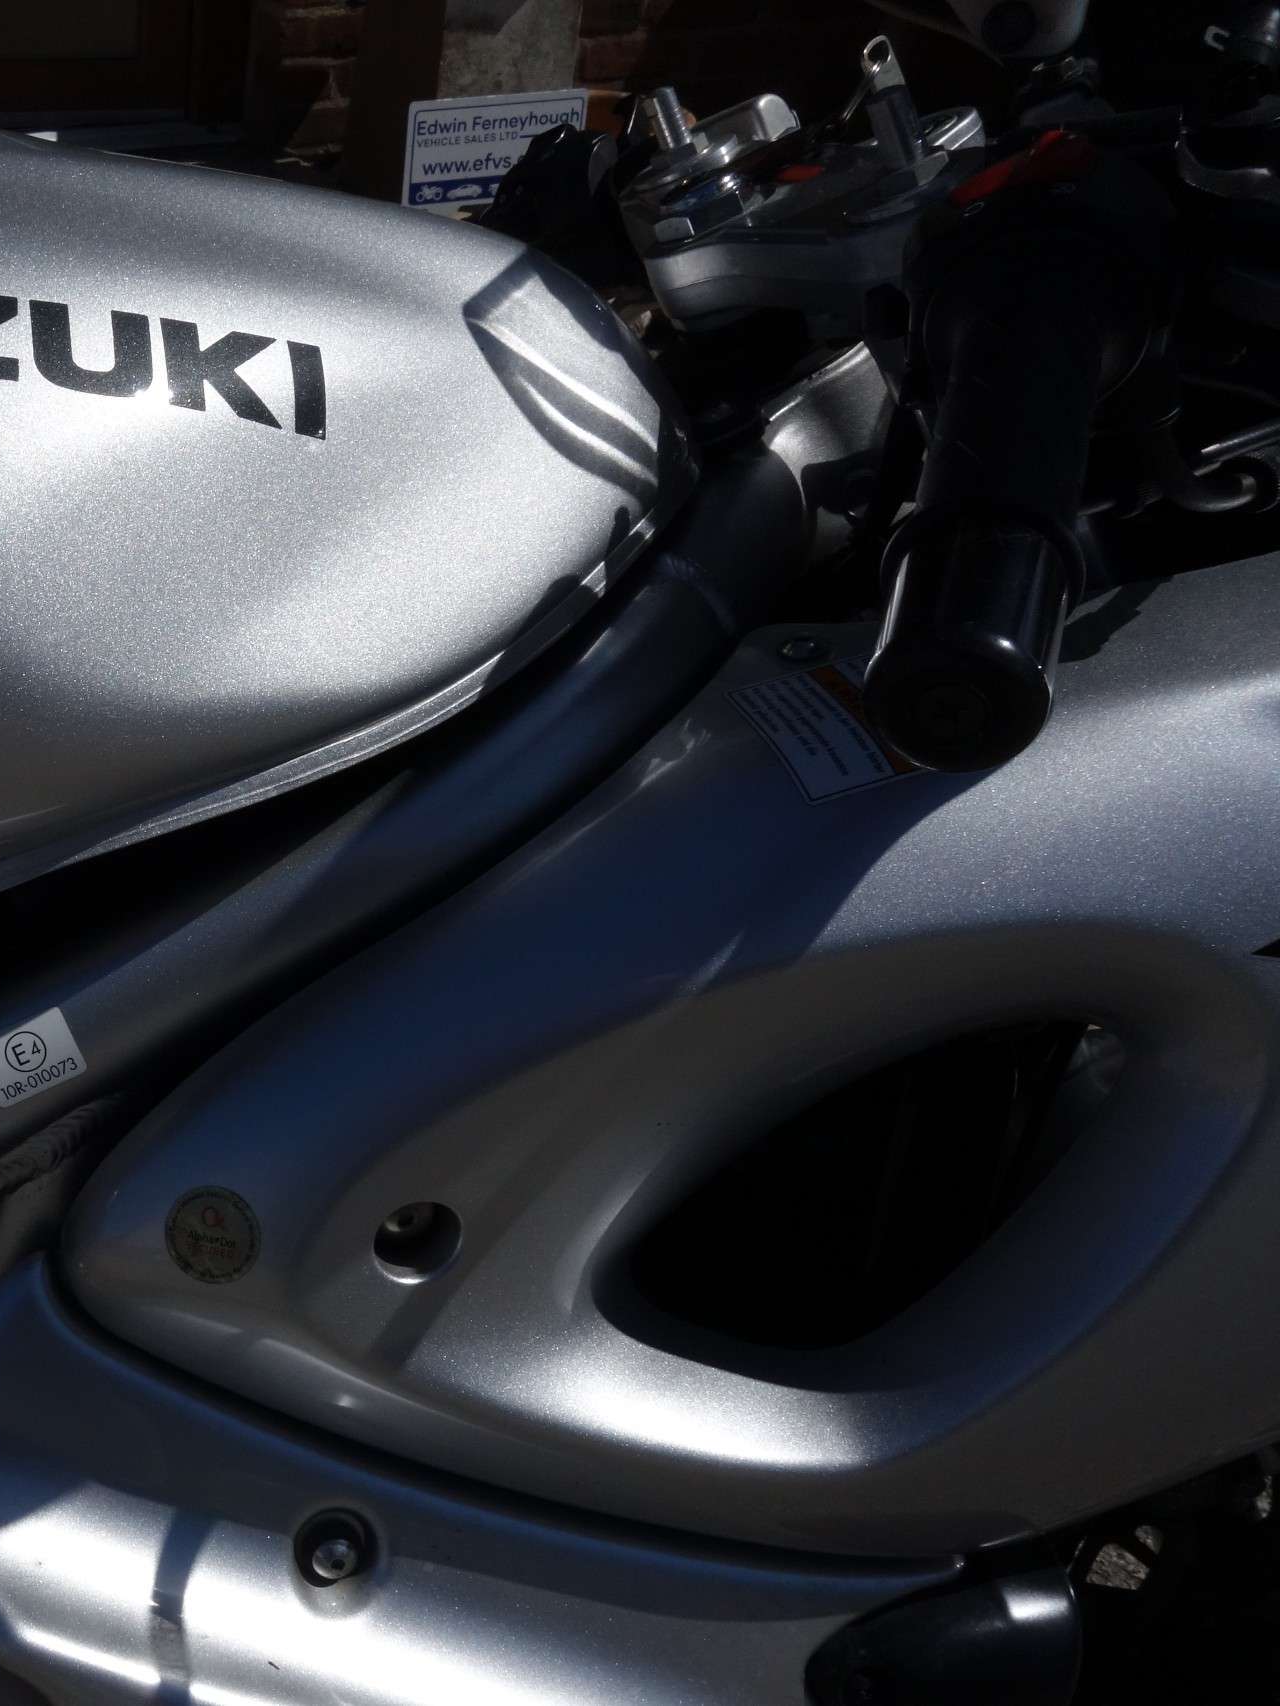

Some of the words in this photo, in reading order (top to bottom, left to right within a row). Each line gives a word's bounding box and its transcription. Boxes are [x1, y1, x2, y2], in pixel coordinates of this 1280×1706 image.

[417, 117, 467, 136] Edwin
[472, 108, 580, 131] Ferneyhough
[417, 137, 460, 148] VEHICLE
[463, 134, 497, 144] SALES
[500, 132, 518, 140] LTD
[0, 1058, 78, 1100] 10R-010073
